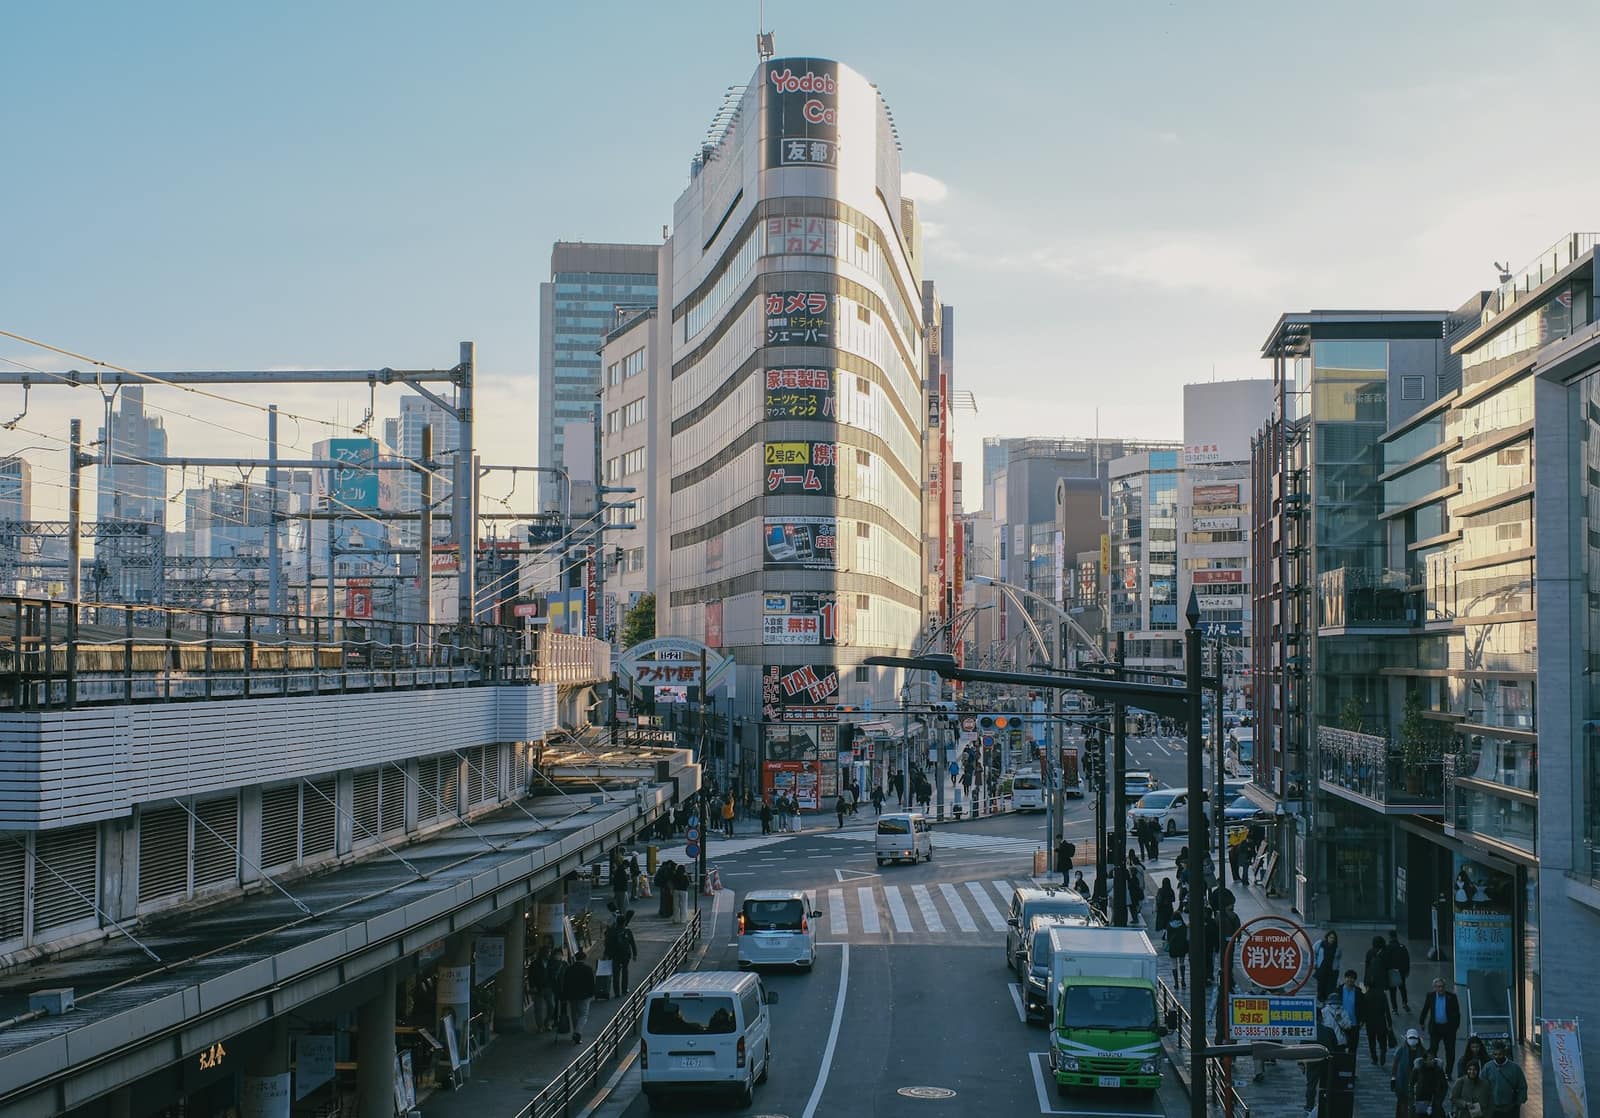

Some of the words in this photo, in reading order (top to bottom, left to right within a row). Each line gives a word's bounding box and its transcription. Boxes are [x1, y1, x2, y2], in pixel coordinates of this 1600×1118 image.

[771, 69, 837, 94] Yodob
[767, 293, 827, 315] カメラ
[768, 329, 829, 342] シェーバー
[767, 368, 829, 390] 家電製品
[767, 394, 817, 406] スーツケース
[789, 406, 817, 416] インク
[767, 446, 806, 463] 2号店へ
[768, 469, 822, 491] ゲーム
[780, 665, 820, 696] TAX
[807, 672, 838, 704] FREE
[1247, 946, 1297, 969] 消火栓
